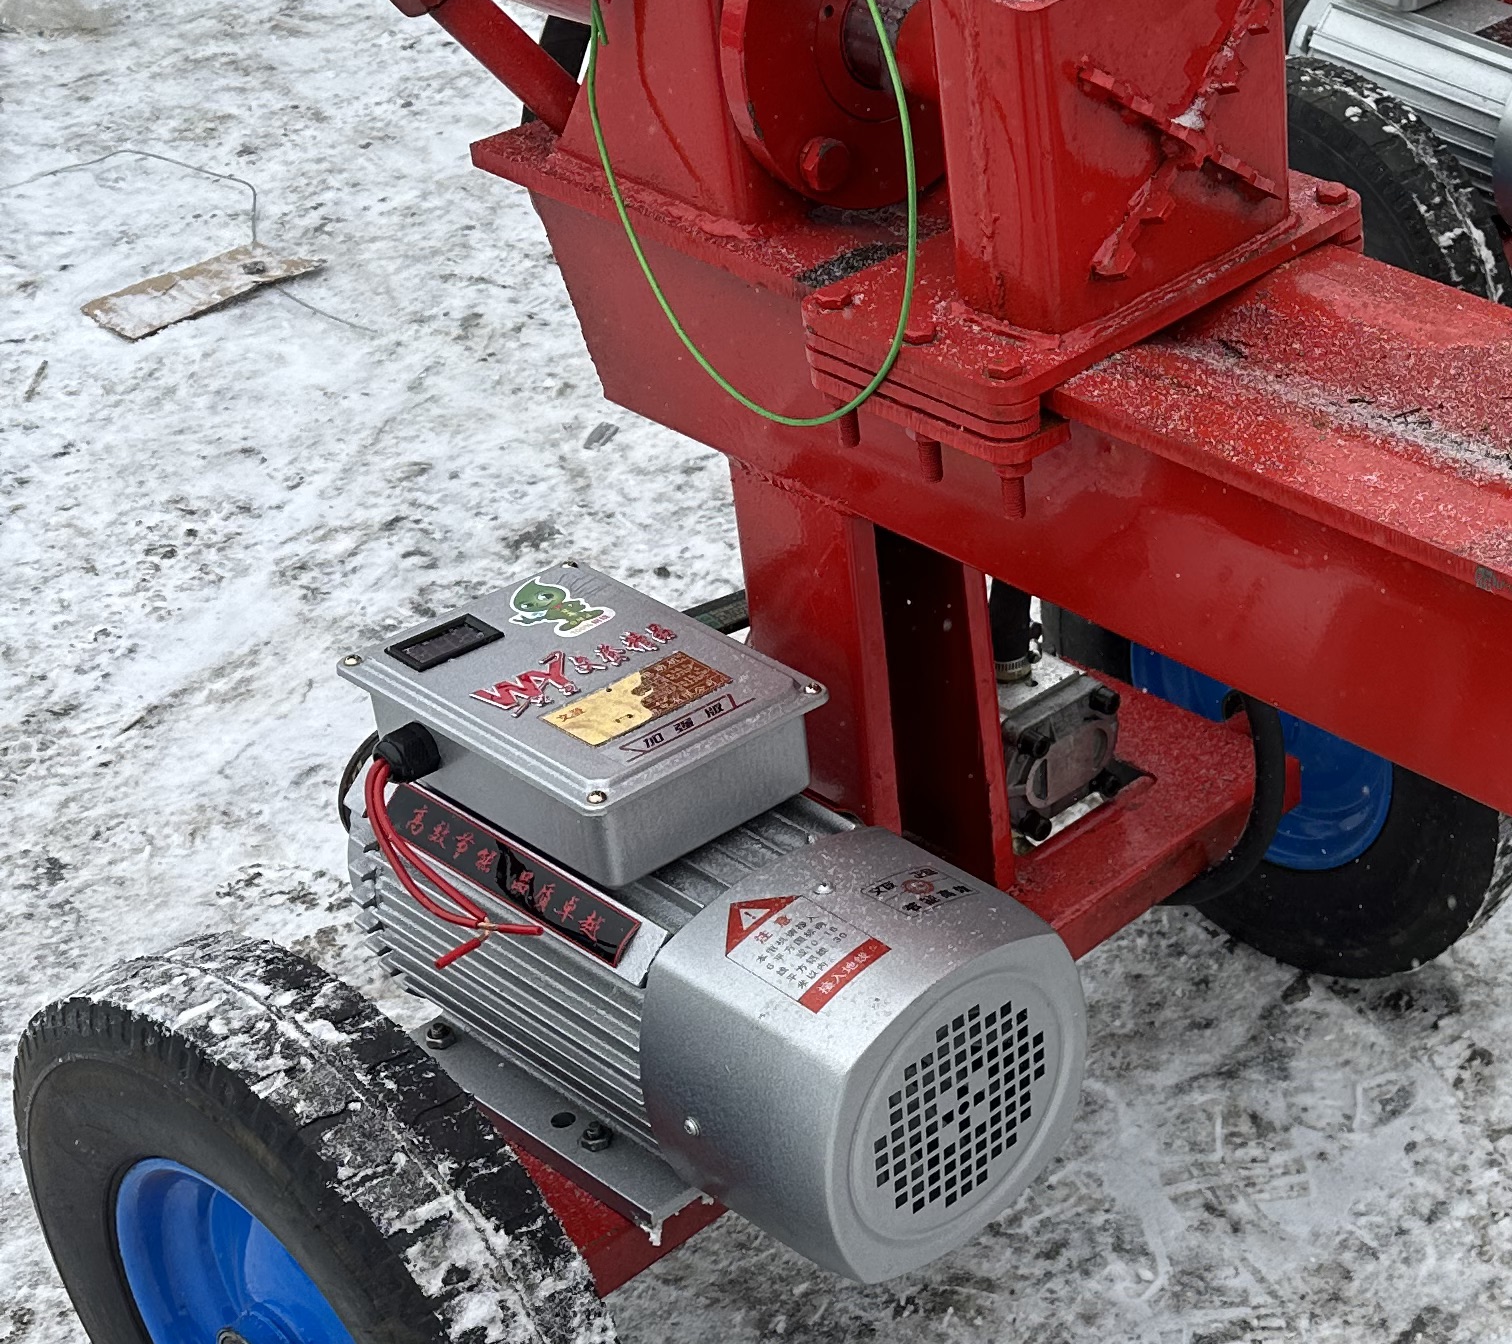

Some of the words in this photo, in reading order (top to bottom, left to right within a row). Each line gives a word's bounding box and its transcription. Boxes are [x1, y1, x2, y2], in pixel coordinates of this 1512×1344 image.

[405, 804, 498, 873] 高效节能
[511, 869, 606, 944] 品质卓越
[754, 914, 793, 944] 注意
